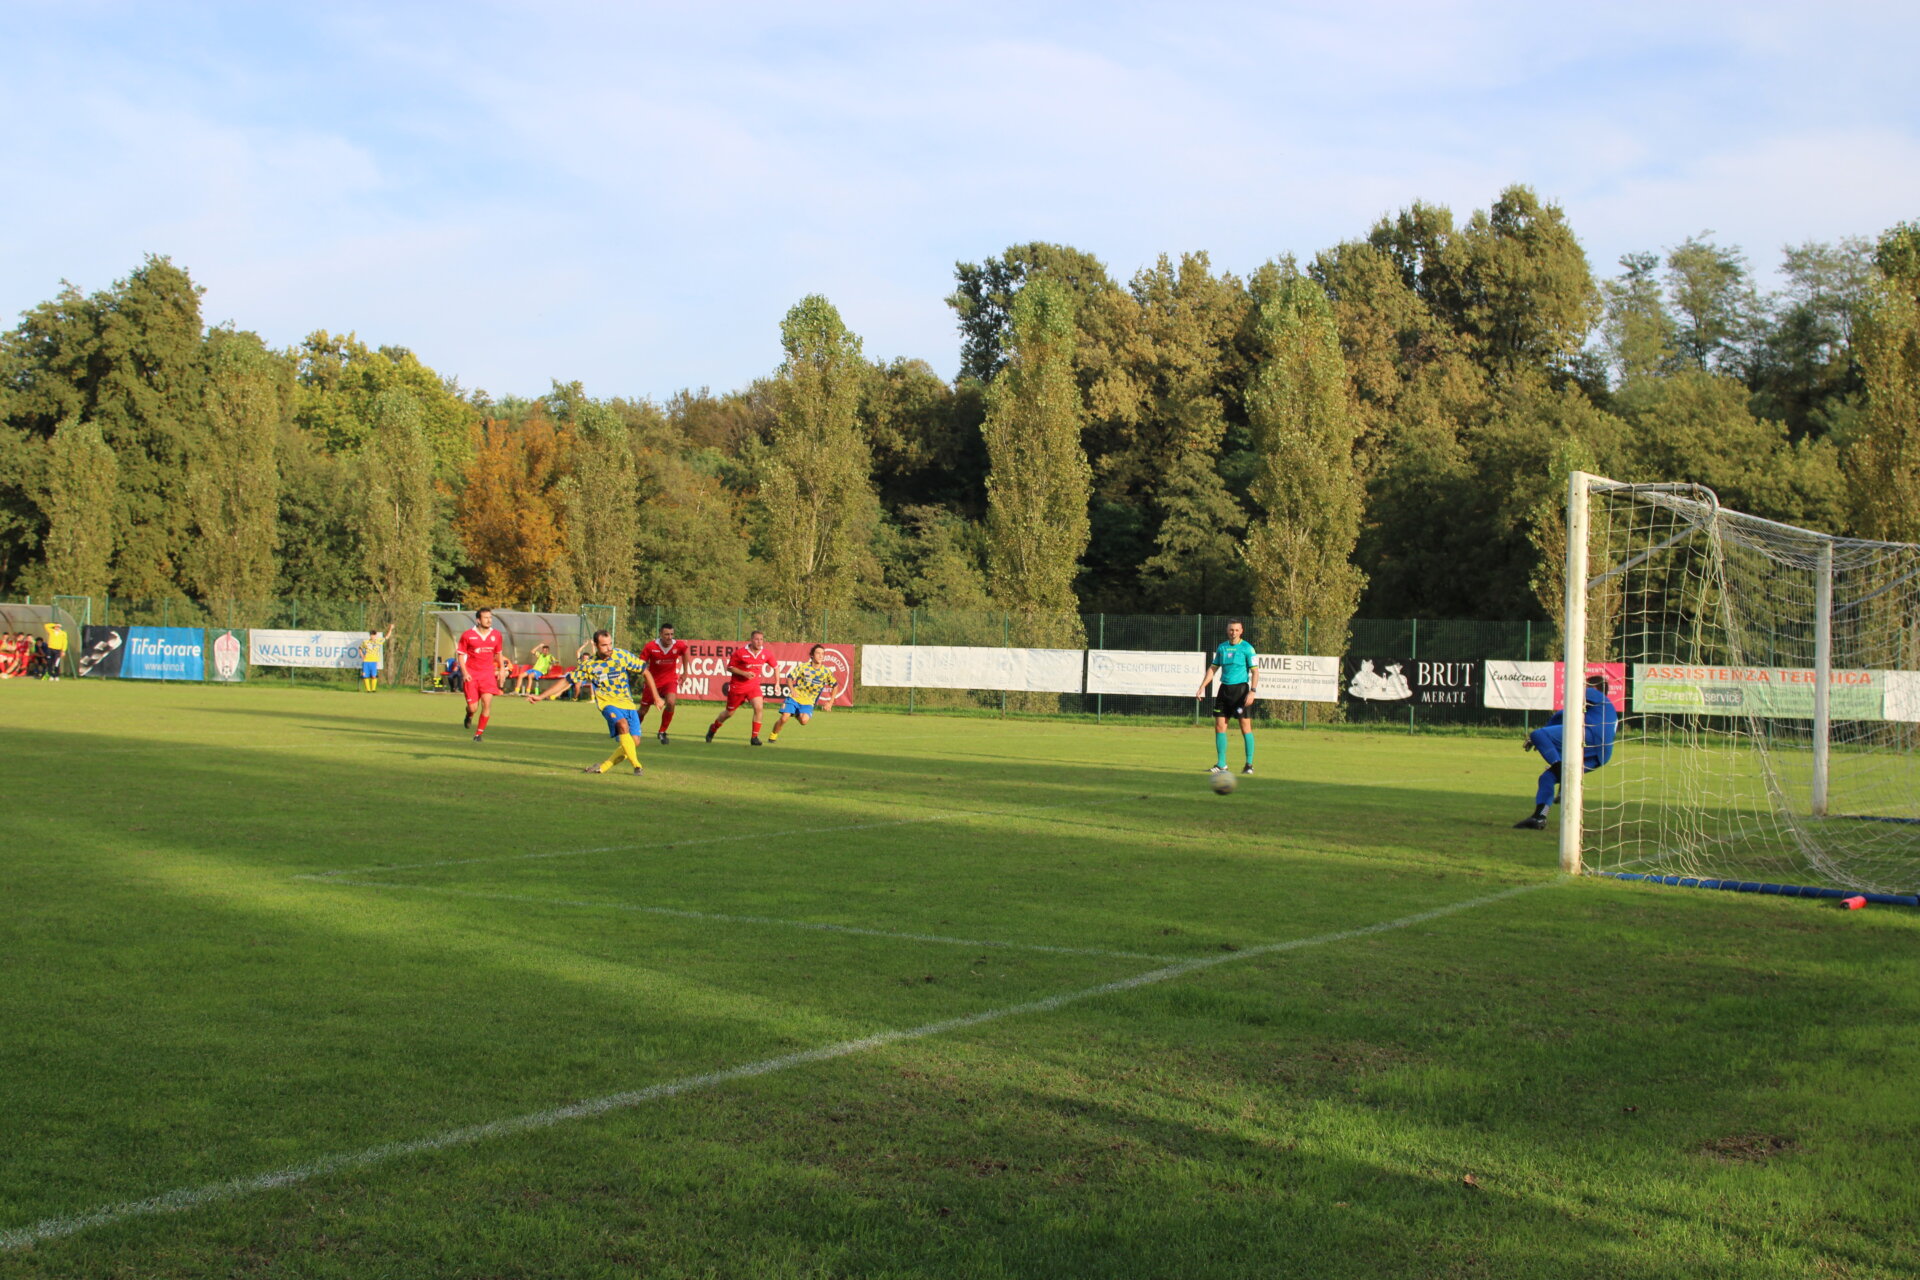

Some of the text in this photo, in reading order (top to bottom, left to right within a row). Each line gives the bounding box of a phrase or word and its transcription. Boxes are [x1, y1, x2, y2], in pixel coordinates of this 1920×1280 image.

[131, 638, 201, 657] TiFaForare
[259, 644, 310, 657] WALTER
[1258, 657, 1319, 672] MME SRL
[1417, 662, 1475, 687] BRUT
[1646, 667, 1872, 685] ASSISTENZA TERICA
[1421, 691, 1466, 704] MERATE
[1704, 691, 1740, 704] service
